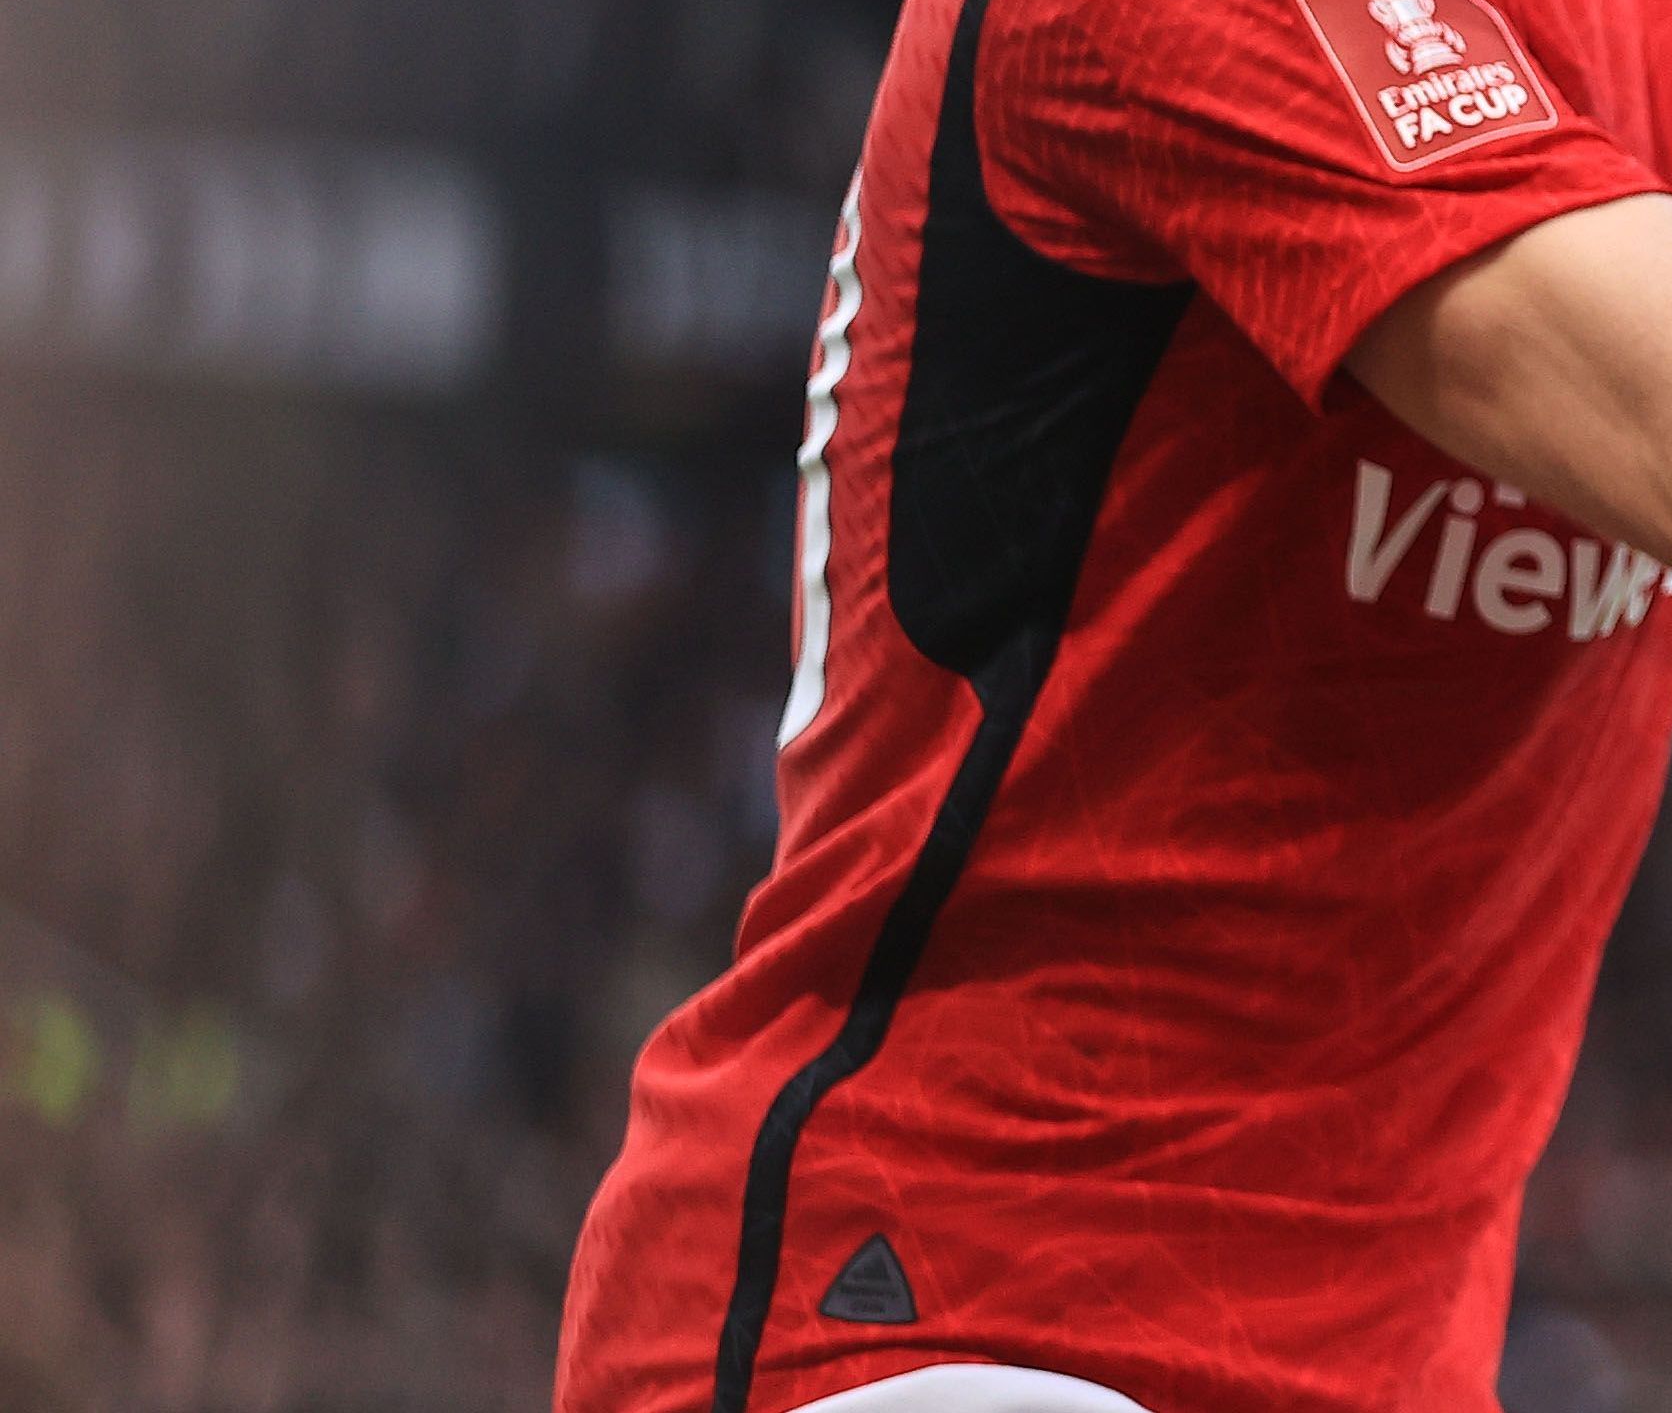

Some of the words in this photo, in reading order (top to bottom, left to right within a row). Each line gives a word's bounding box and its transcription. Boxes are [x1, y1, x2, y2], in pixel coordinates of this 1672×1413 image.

[1377, 60, 1517, 119] Emirates
[1394, 106, 1453, 150] FA
[1448, 82, 1529, 128] CUP
